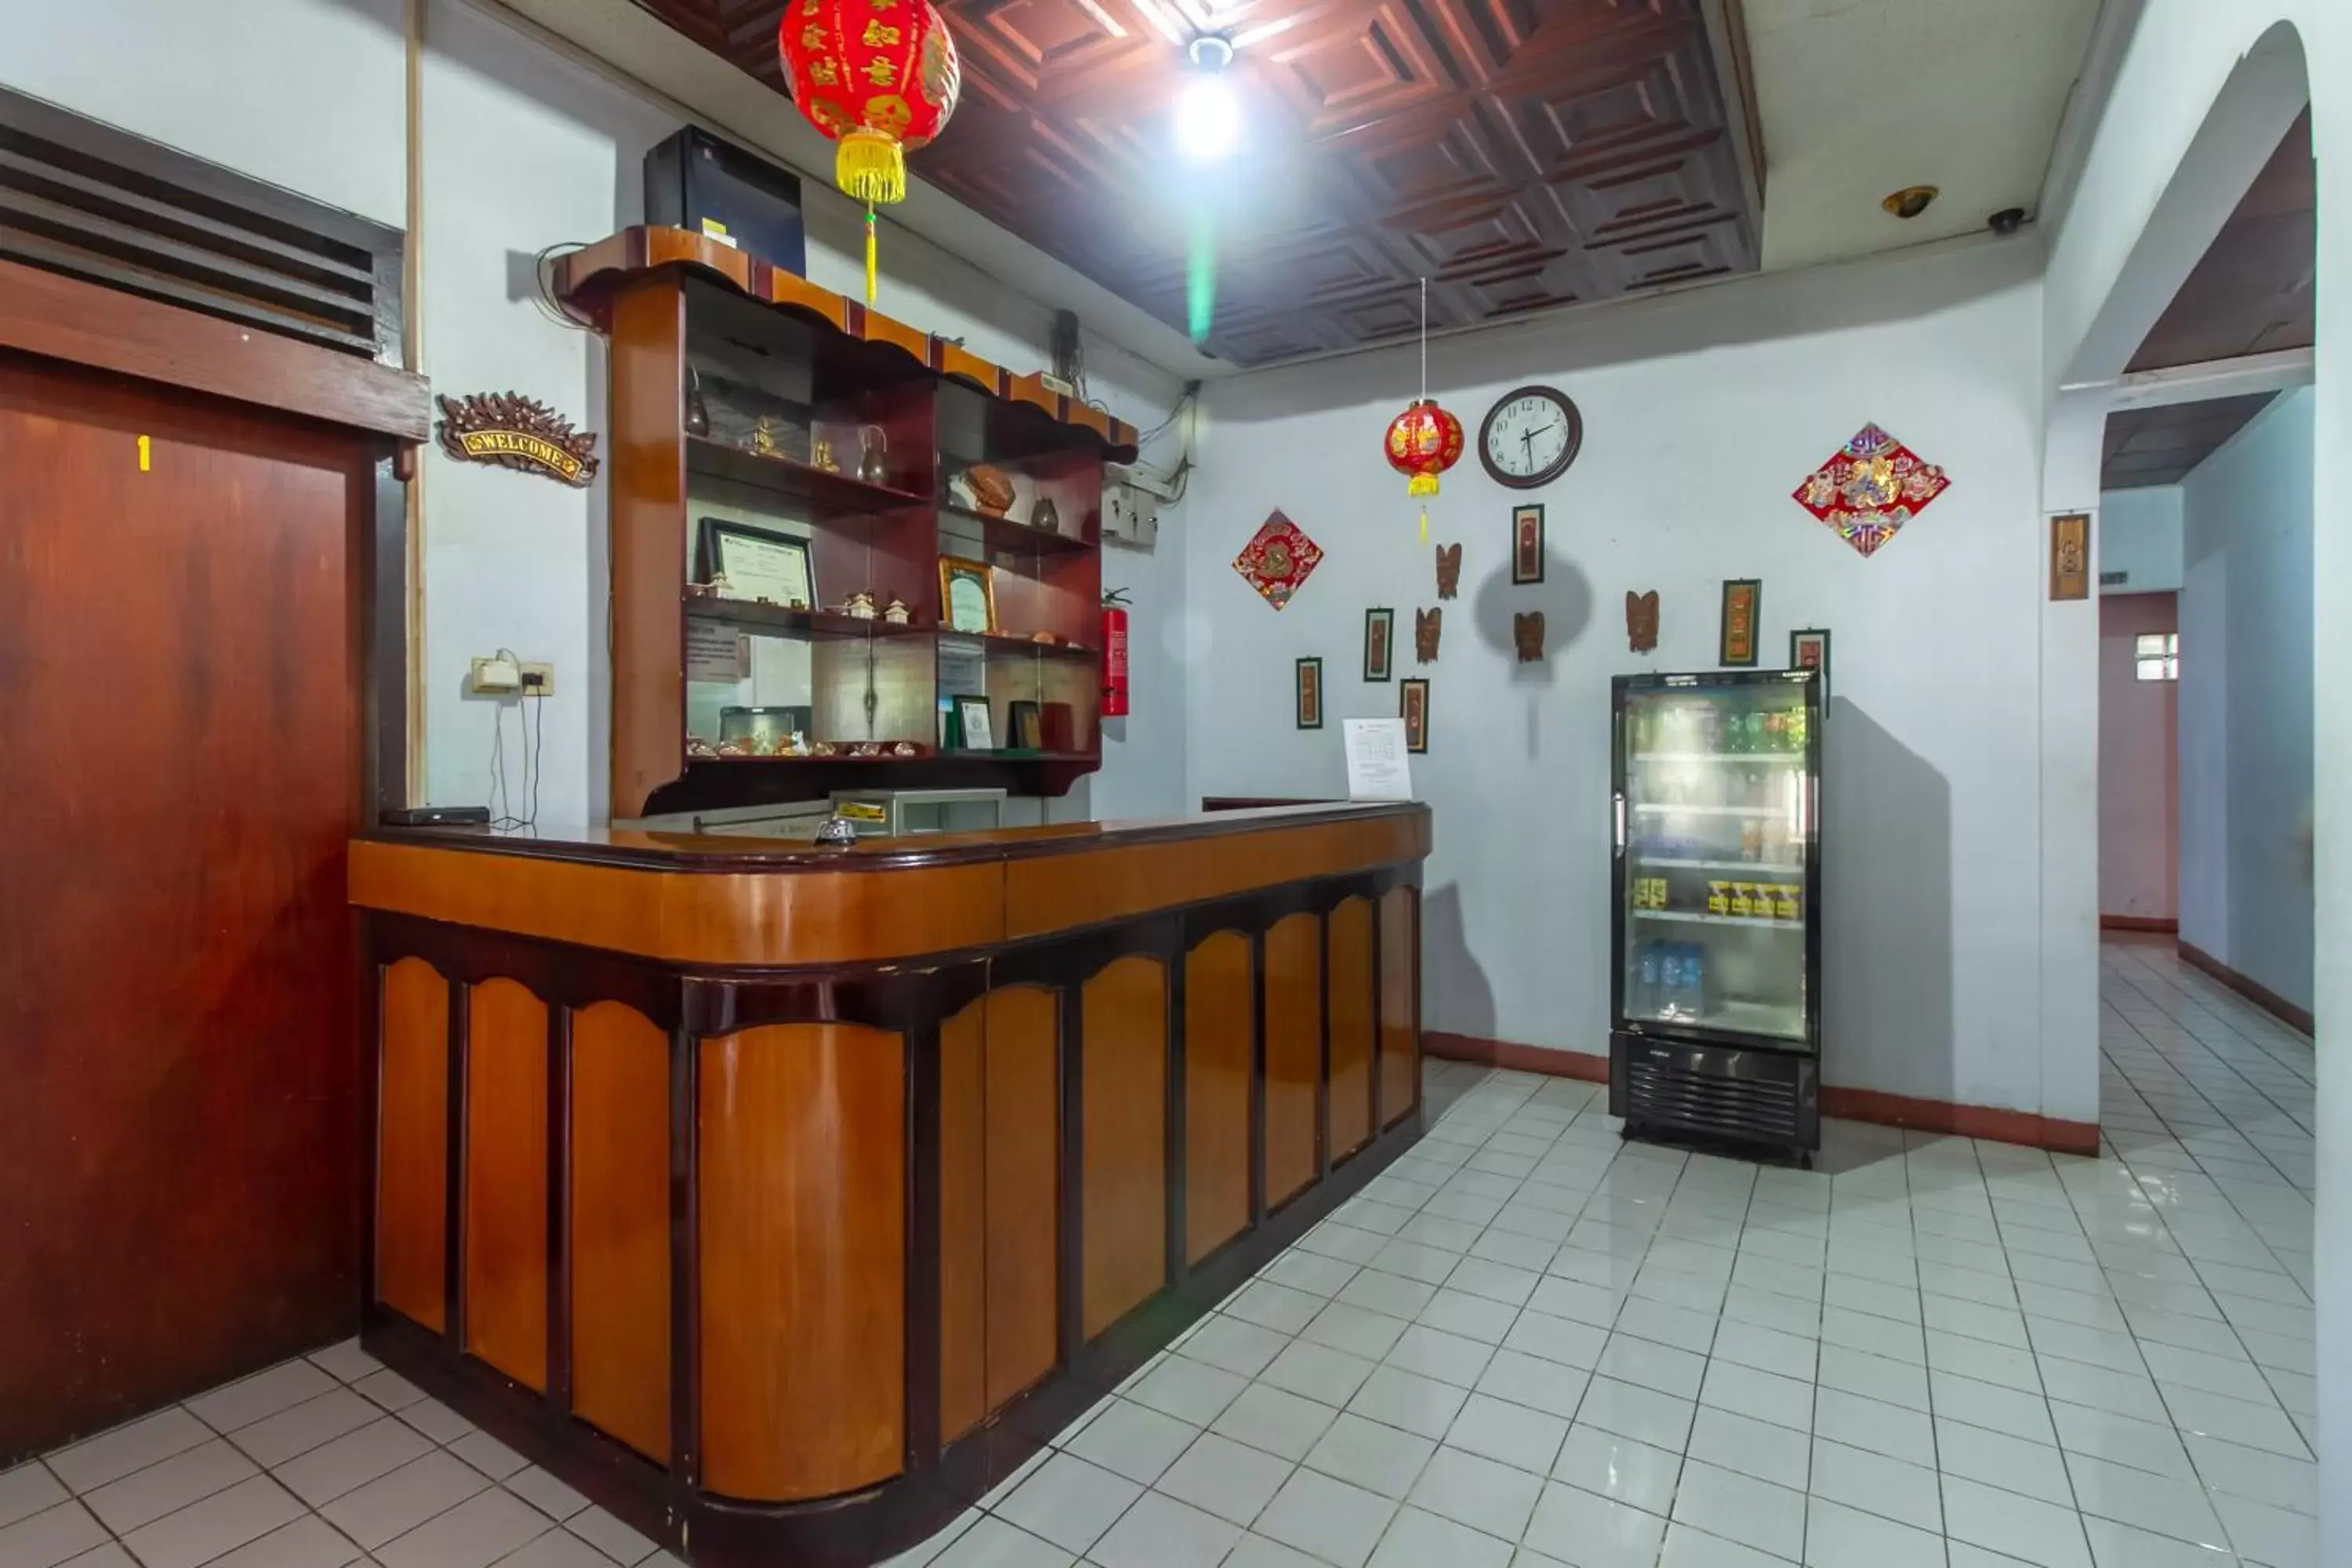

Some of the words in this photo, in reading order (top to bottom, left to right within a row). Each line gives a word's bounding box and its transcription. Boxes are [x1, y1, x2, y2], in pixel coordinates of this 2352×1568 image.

[1522, 399, 1533, 411] 12
[1508, 407, 1517, 419] 11
[1497, 420, 1508, 434] 10
[481, 433, 562, 465] WELCOME
